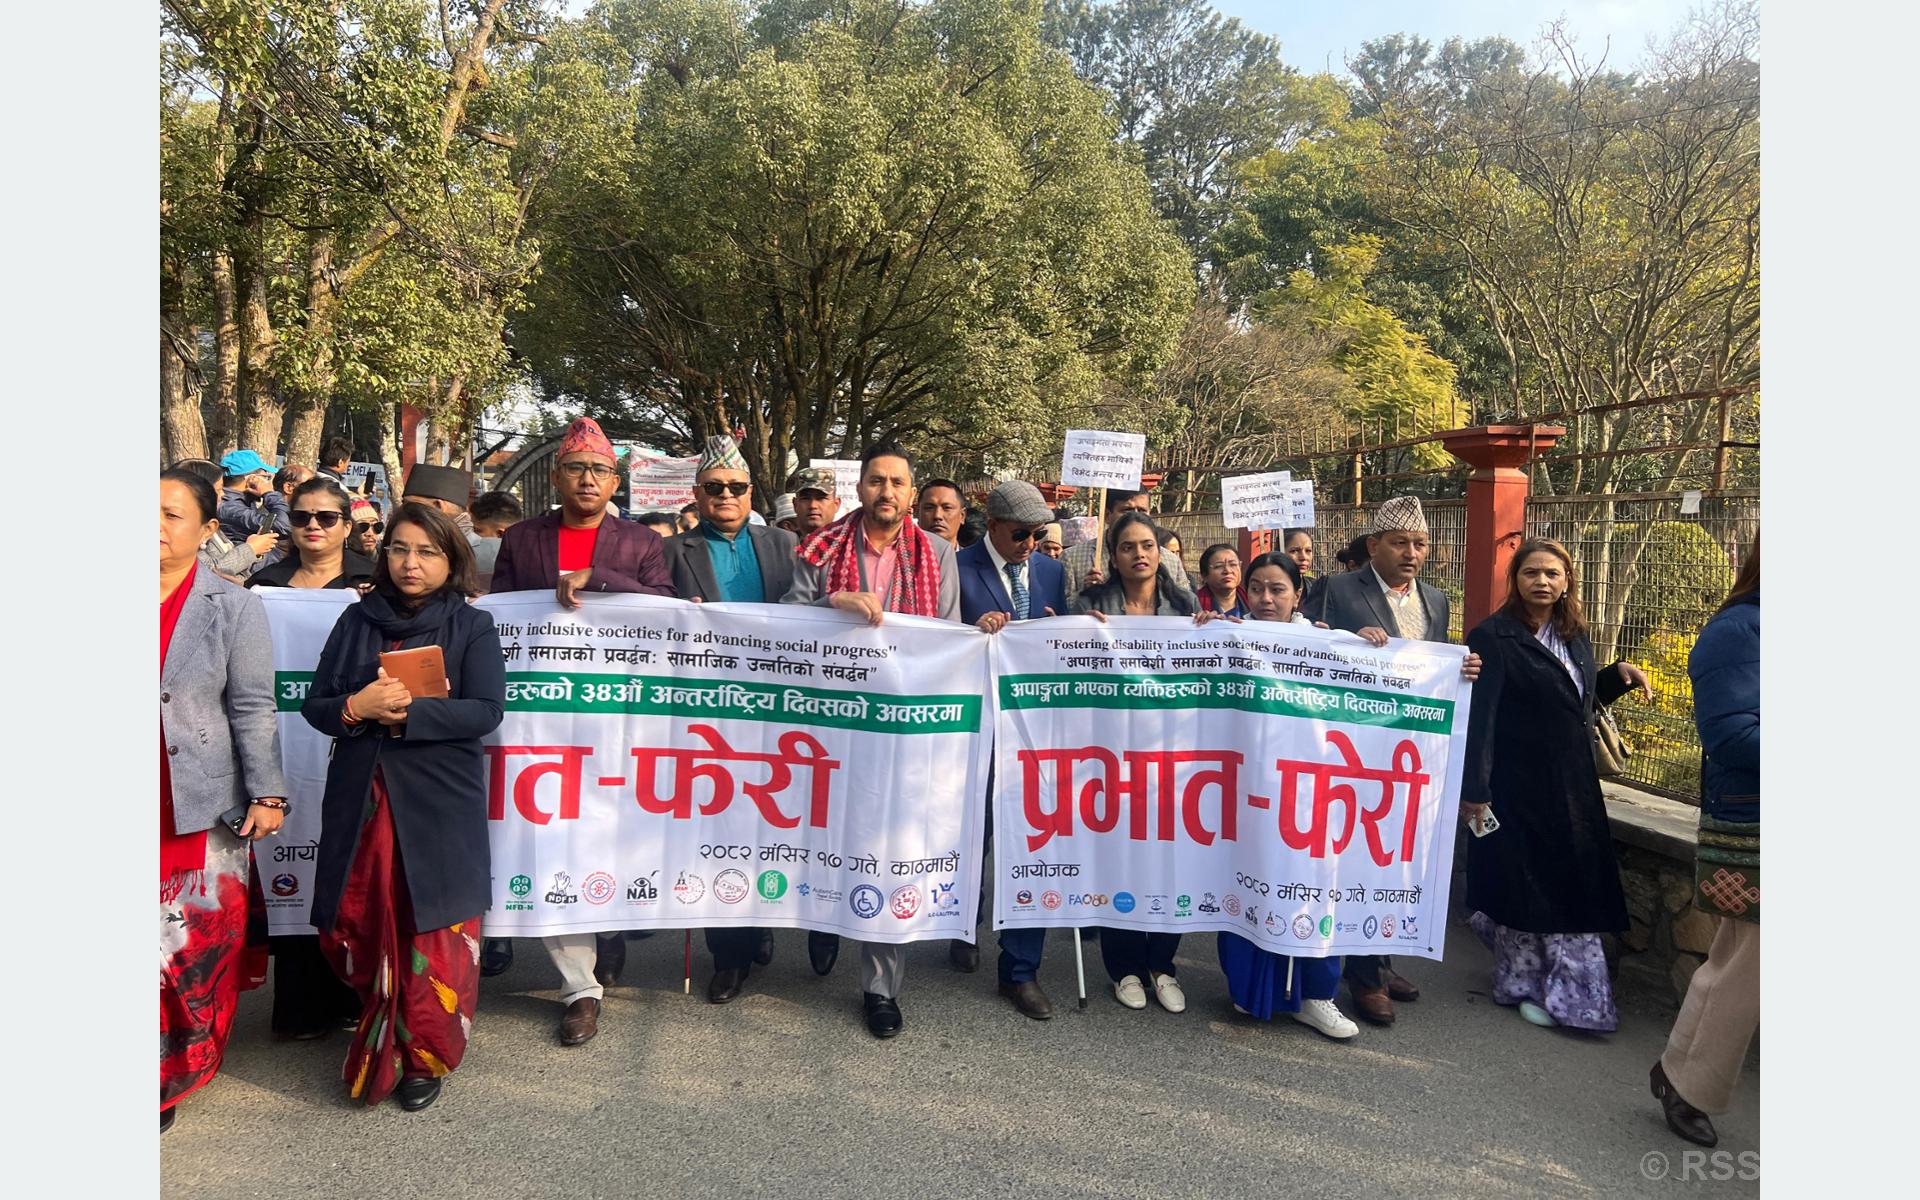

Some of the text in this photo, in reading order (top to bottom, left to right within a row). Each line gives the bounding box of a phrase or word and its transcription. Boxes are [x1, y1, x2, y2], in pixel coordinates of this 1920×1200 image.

[496, 623, 523, 640] ility
[527, 622, 593, 638] inclusive
[597, 624, 662, 641] societies
[667, 627, 689, 643] for
[693, 630, 771, 651] advancing
[775, 639, 818, 654] social
[1112, 638, 1164, 652] disability
[1168, 637, 1220, 651] inclusive
[1222, 638, 1270, 653] societies
[1273, 643, 1291, 656] for
[1293, 646, 1349, 665] advancing
[1351, 655, 1378, 668] social
[528, 643, 596, 662] समाजको
[667, 649, 739, 670] सामाजिक
[747, 655, 814, 677] उन्नतिको
[1119, 654, 1165, 671] समावेशी
[1171, 653, 1222, 669] समाजको
[1272, 660, 1326, 679] सामाजिक
[1330, 668, 1377, 685] उन्नतिको
[505, 676, 574, 702] हरूको
[783, 688, 869, 720] दिवसको
[876, 702, 964, 724] अवसरमा
[1075, 680, 1119, 697] भएका
[1344, 693, 1399, 716] दिवसको
[1402, 702, 1446, 722] अवसरमा
[1018, 730, 1430, 867] प्रभात-फेरी
[700, 844, 751, 860] २०८२
[759, 842, 811, 865] मंसिर
[817, 851, 842, 869] १७
[848, 853, 881, 878] गते,
[1011, 858, 1081, 879] आयोजक
[627, 887, 657, 900] NAB
[1236, 871, 1270, 897] २०८२
[1277, 882, 1323, 903] मंसिर
